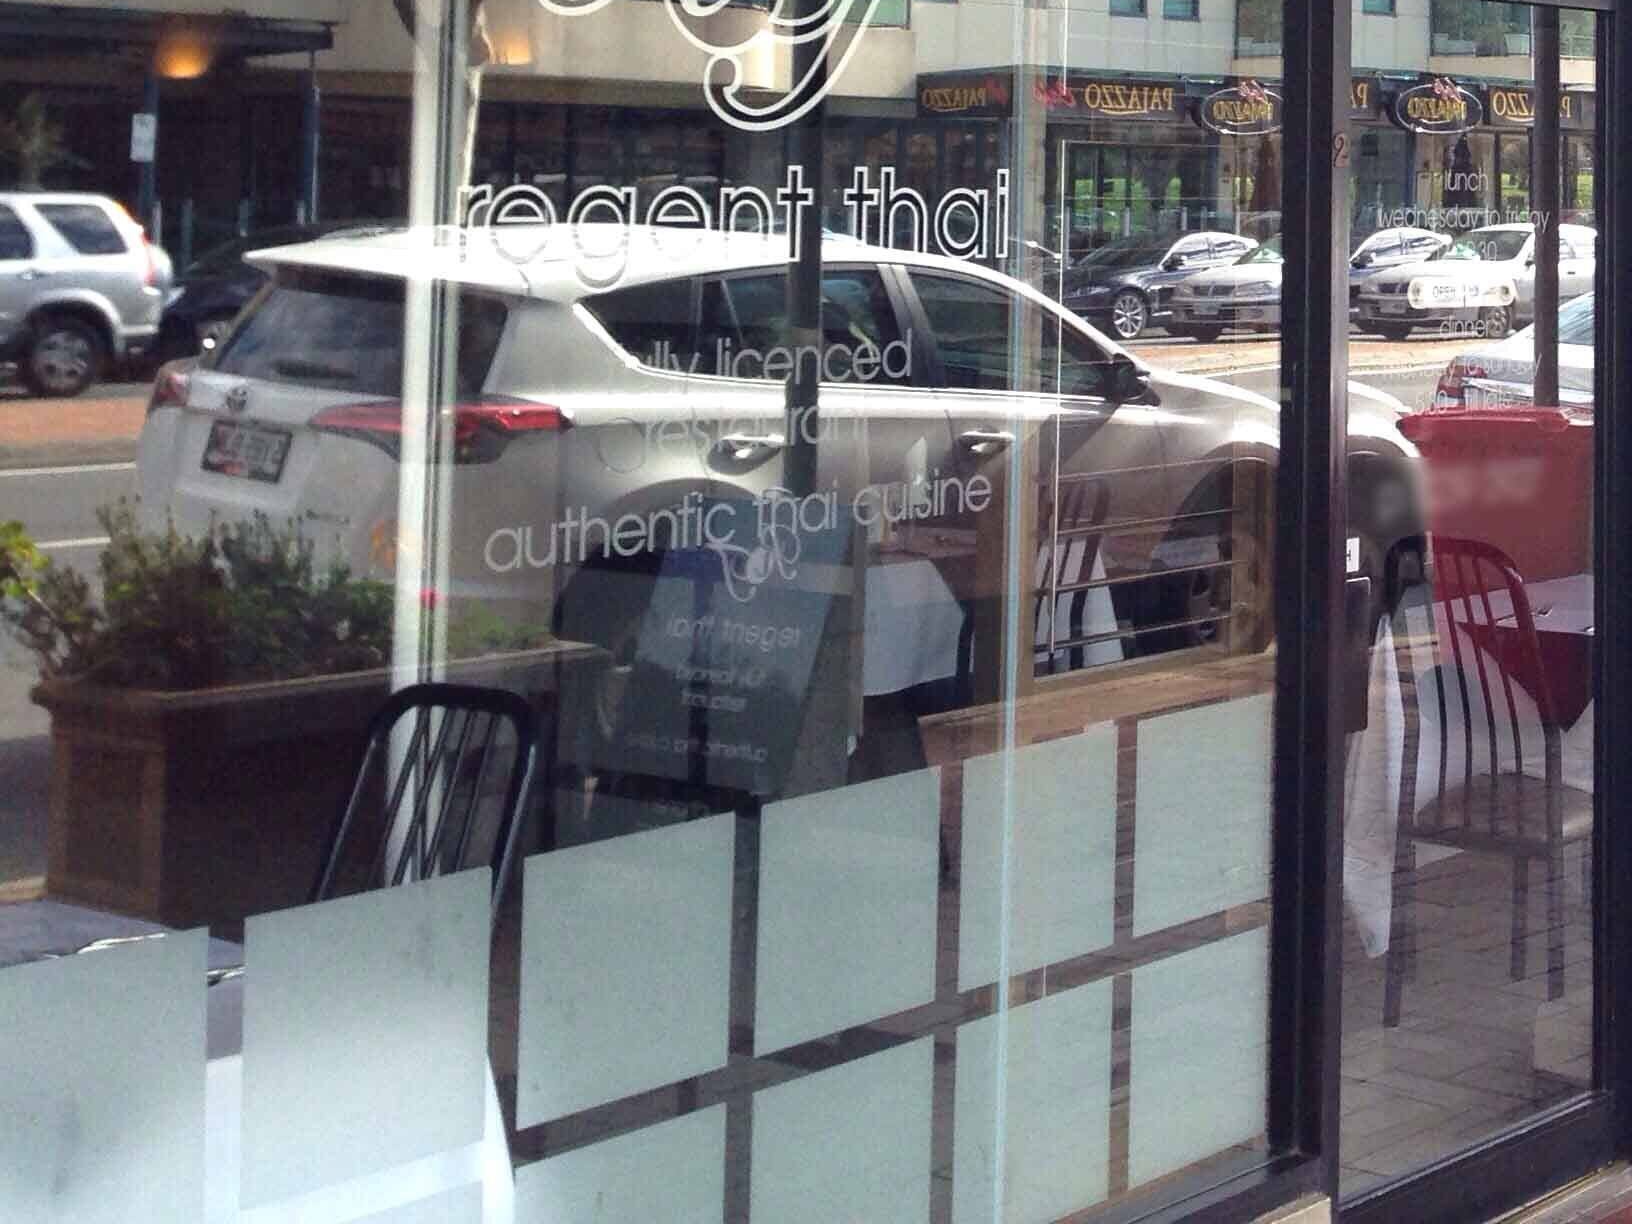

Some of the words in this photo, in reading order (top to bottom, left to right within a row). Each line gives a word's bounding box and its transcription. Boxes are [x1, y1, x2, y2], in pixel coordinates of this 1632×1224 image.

[1443, 167, 1489, 192] lunch
[457, 165, 812, 292] regent
[844, 166, 1009, 259] thai
[1377, 202, 1480, 232] wednesday
[1484, 202, 1501, 227] to
[1439, 314, 1490, 338] dinner
[715, 329, 912, 381] licenced
[484, 491, 736, 573] authentic
[752, 478, 838, 533] thai
[853, 471, 993, 526] cuisine
